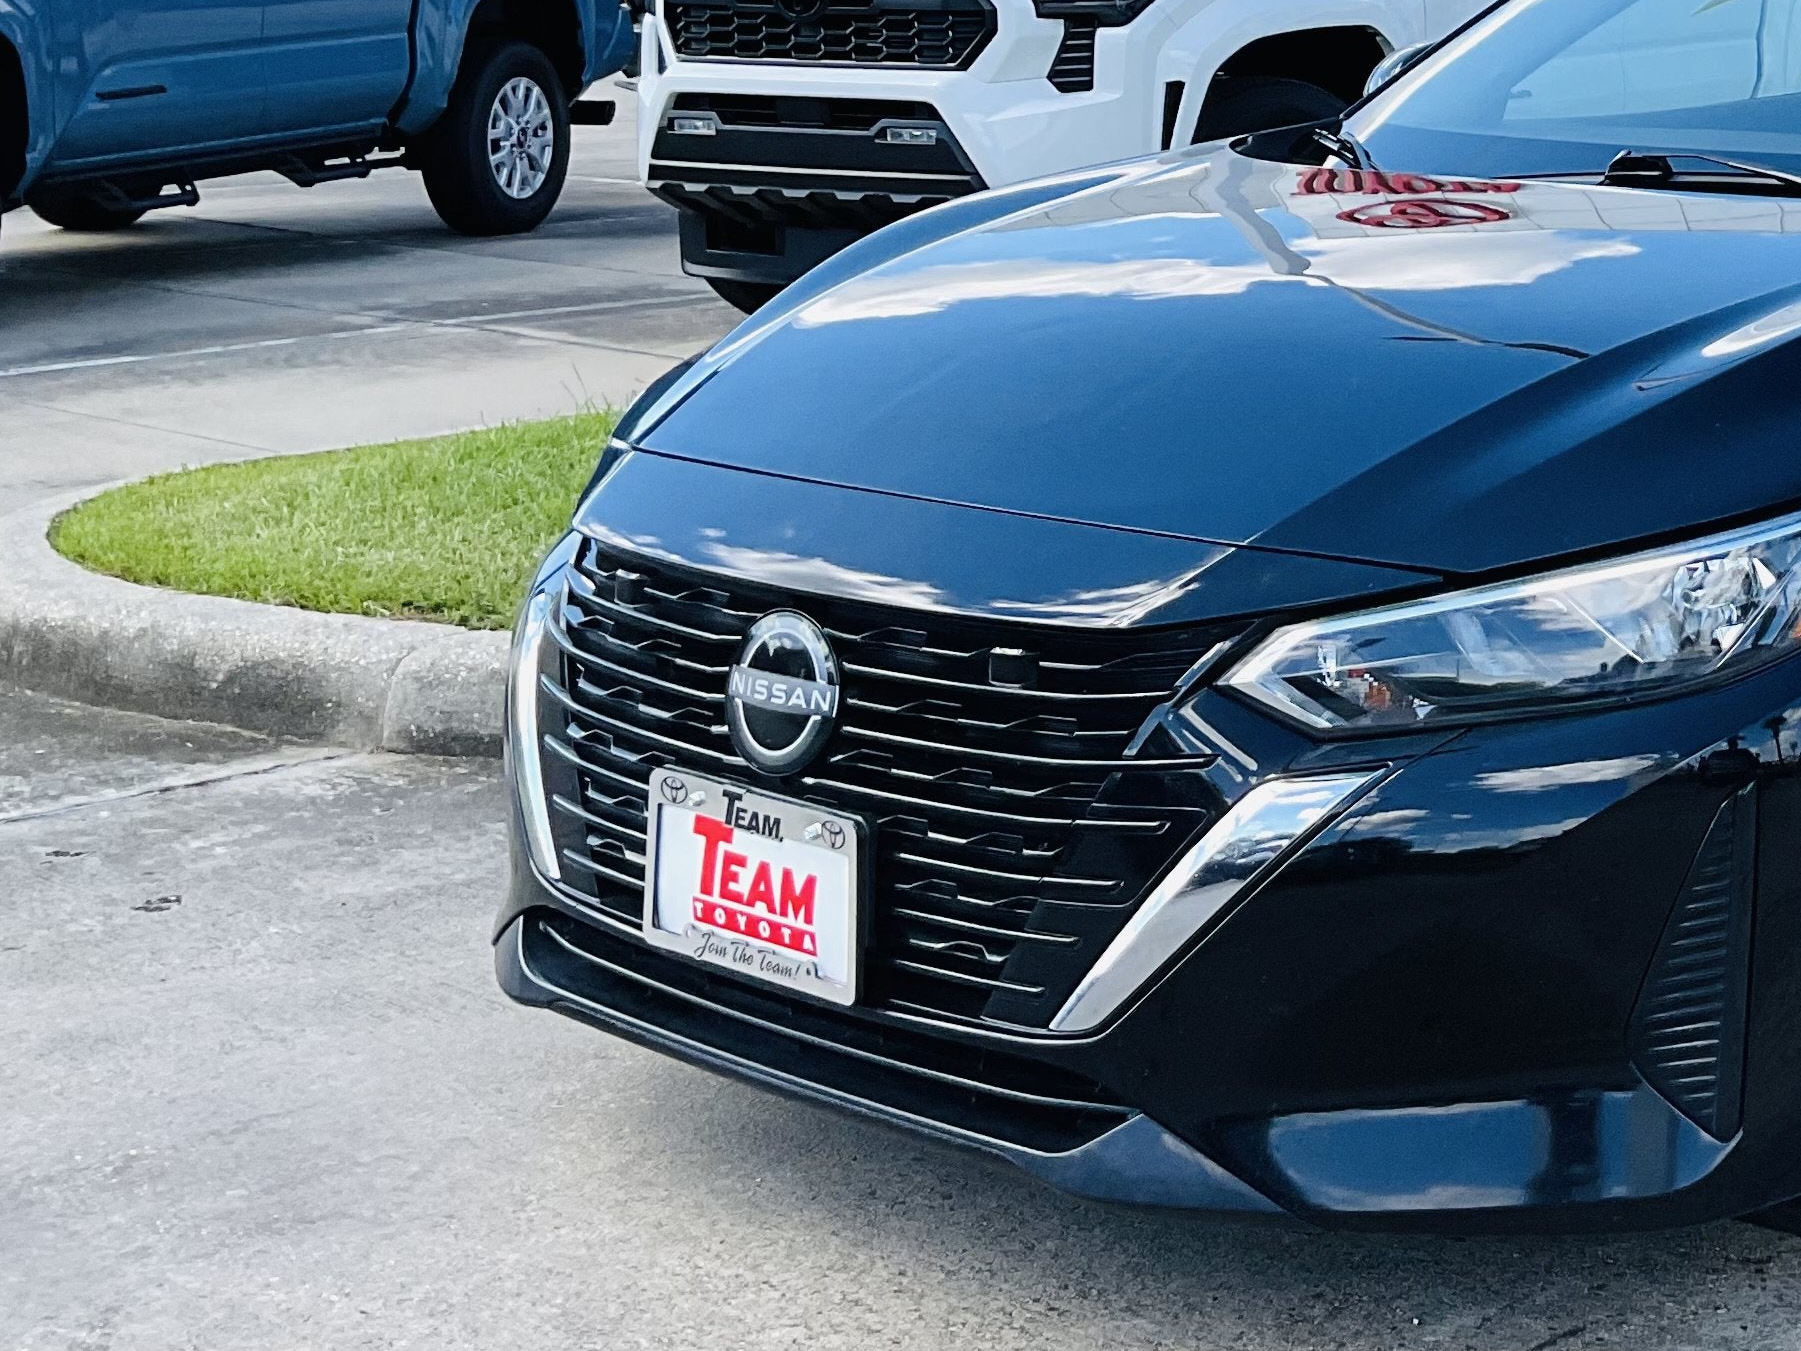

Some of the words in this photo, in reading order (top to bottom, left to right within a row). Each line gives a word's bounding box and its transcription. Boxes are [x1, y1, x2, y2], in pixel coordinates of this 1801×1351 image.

[731, 670, 832, 712] NISSAN
[692, 813, 819, 927] TEAM
[694, 901, 815, 952] TOYOTA
[694, 932, 729, 959] Join
[730, 940, 755, 967] The
[758, 949, 802, 980] Team!
